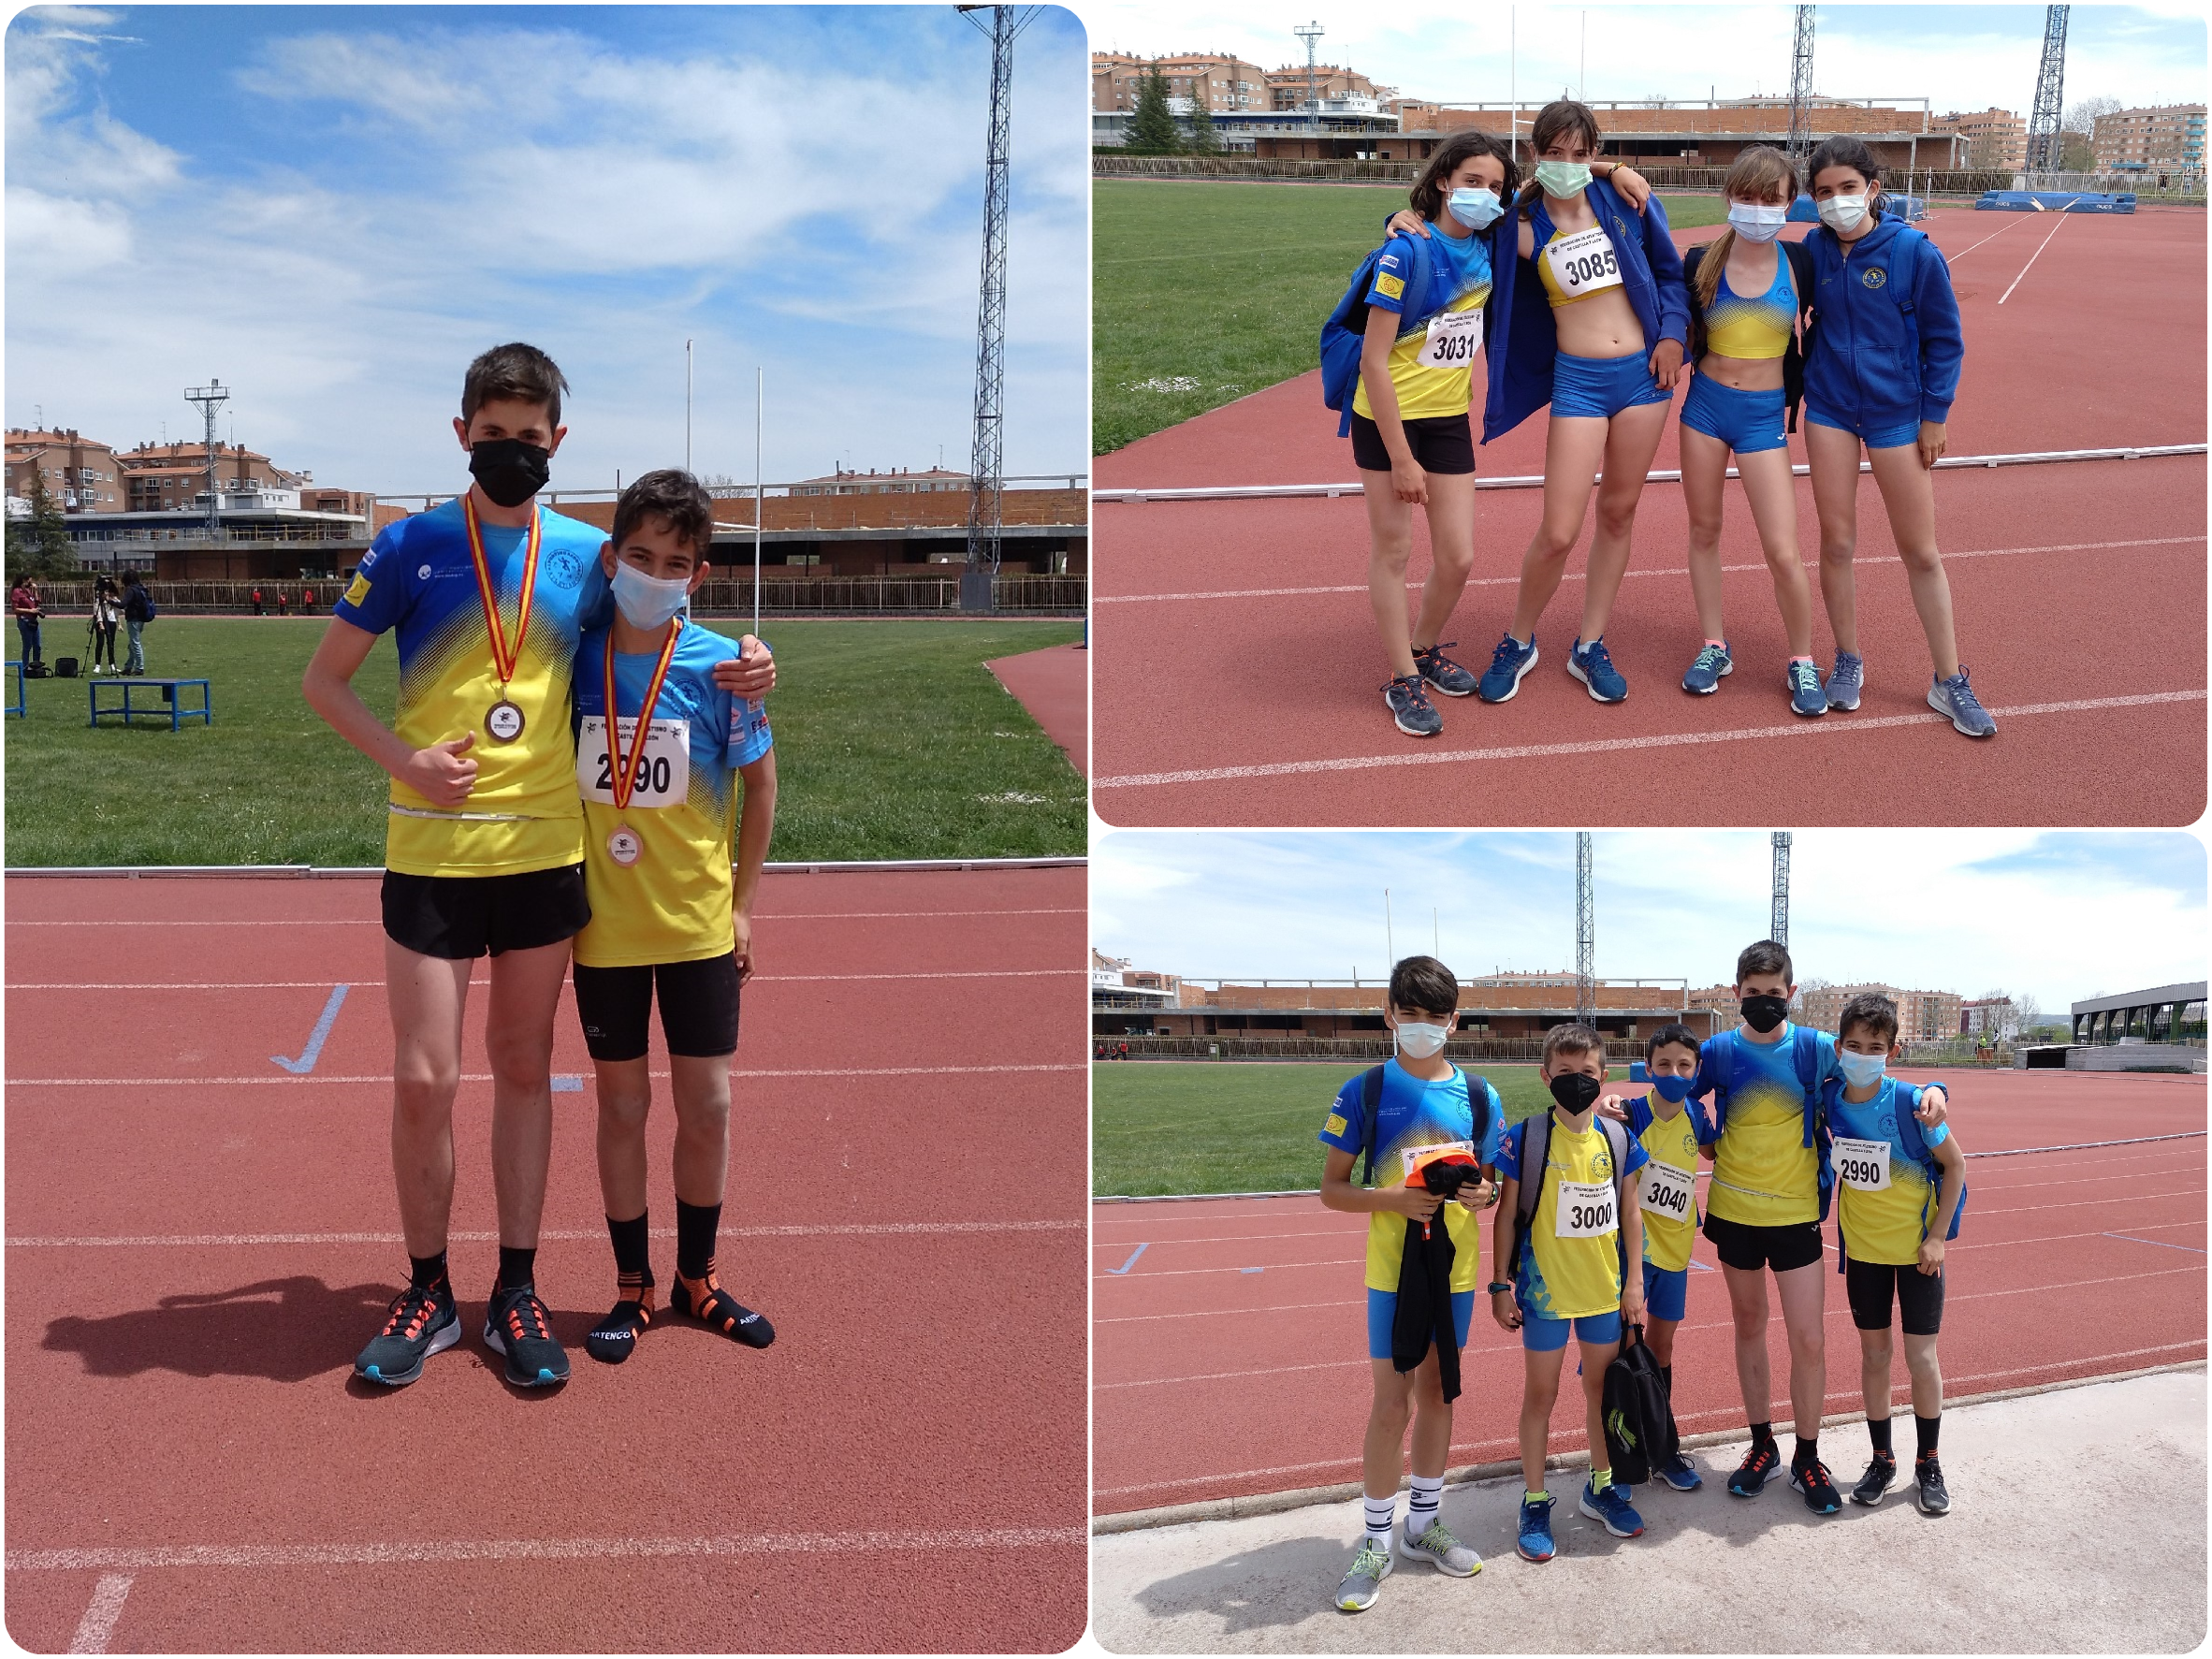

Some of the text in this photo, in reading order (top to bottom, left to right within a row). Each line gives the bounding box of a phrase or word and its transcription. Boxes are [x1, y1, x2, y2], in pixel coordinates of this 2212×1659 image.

[1565, 250, 1617, 286] 3085
[1433, 334, 1475, 360] 3031
[1841, 1158, 1881, 1184] 2990
[1647, 1182, 1687, 1214] 3040
[1570, 1201, 1612, 1230] 3000
[589, 1332, 632, 1340] ARTENGO
